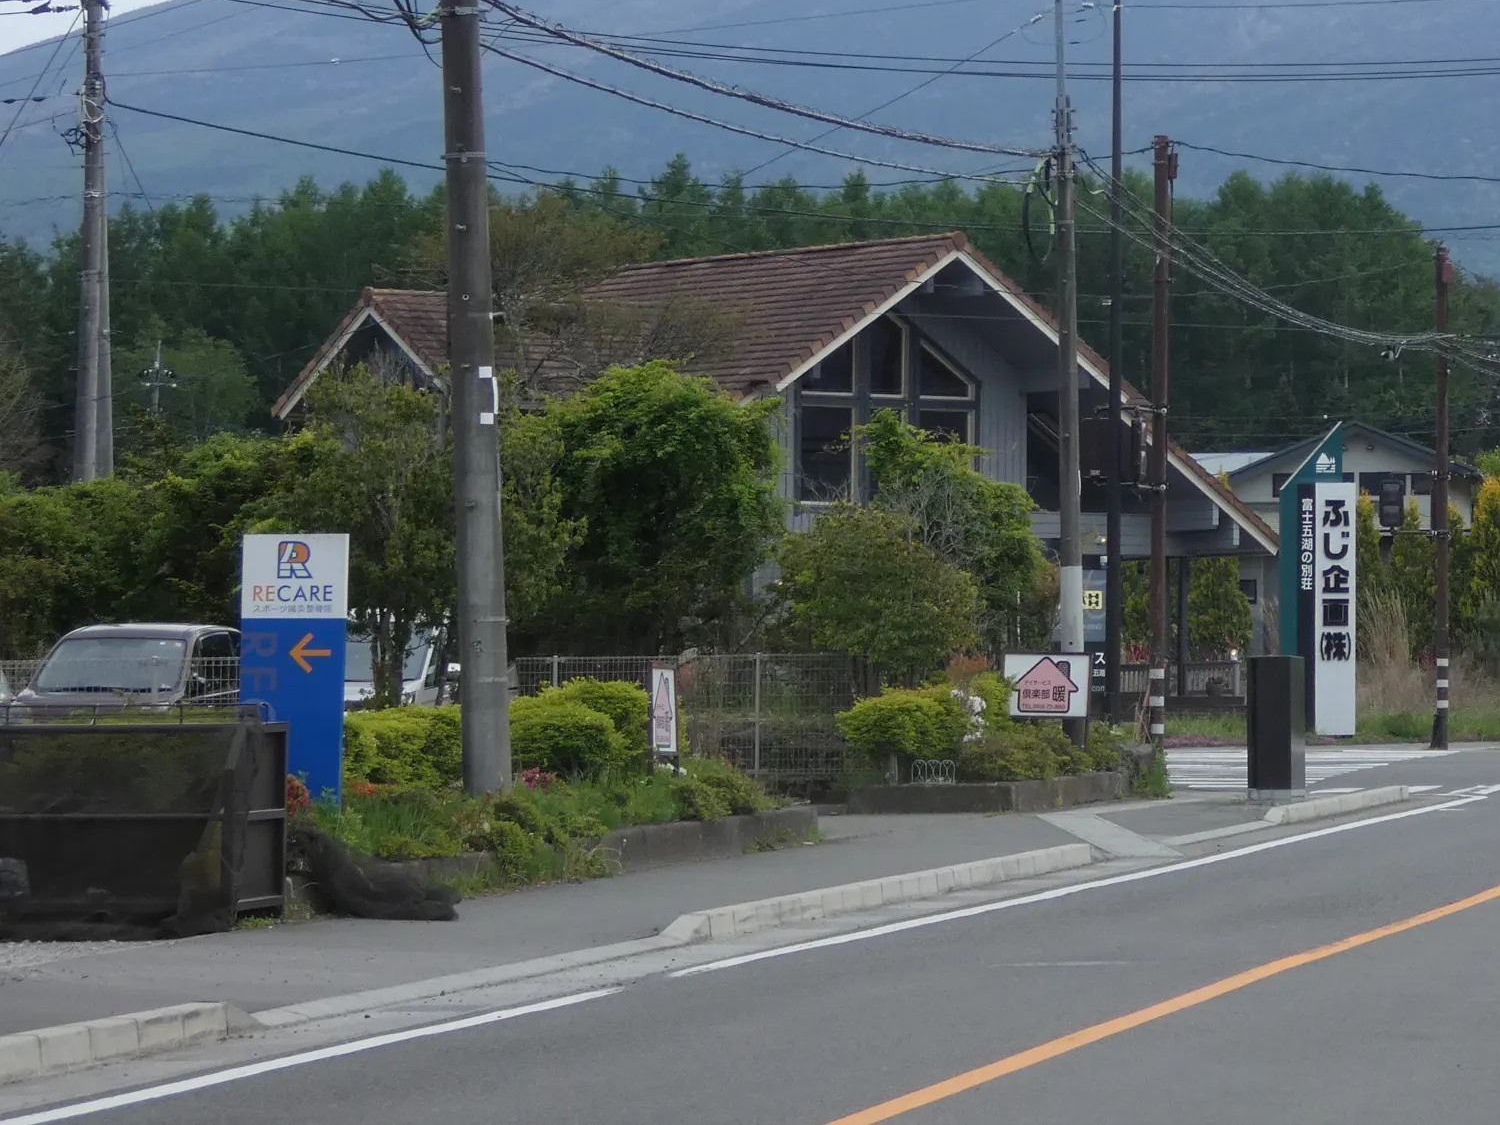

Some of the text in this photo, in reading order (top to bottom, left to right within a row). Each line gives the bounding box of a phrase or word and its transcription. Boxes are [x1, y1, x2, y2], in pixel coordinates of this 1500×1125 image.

[1300, 498, 1314, 591] 富士五湖の別荘
[252, 584, 333, 602] RECARE
[1052, 685, 1066, 702] 暖
